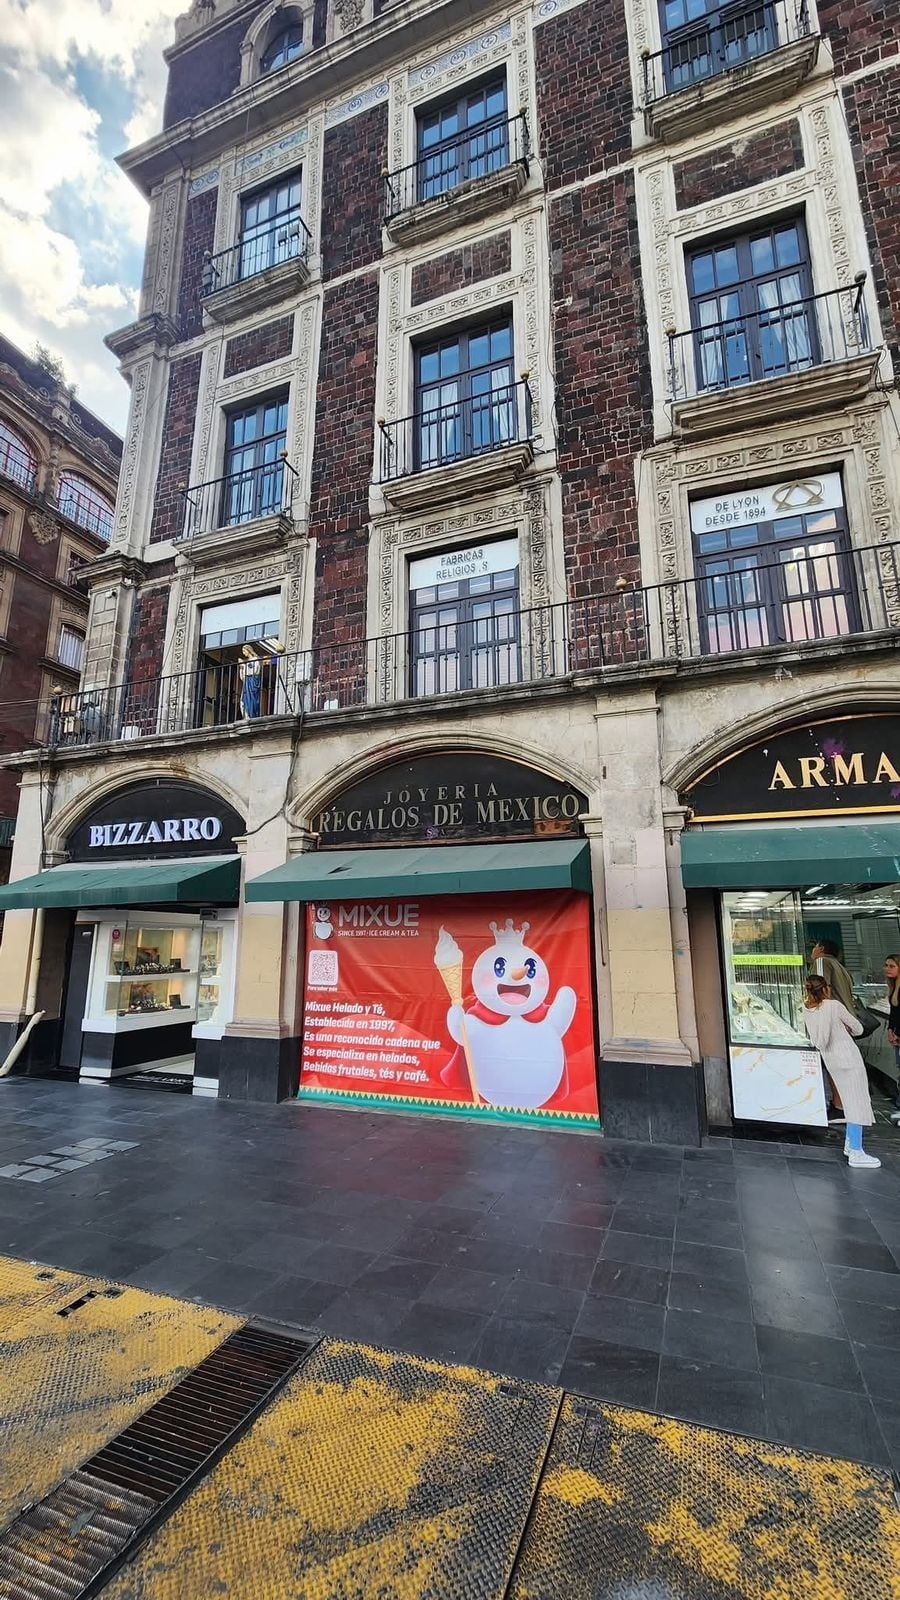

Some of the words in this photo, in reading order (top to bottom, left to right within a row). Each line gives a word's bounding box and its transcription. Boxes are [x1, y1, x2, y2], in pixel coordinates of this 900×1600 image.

[715, 501, 730, 513] DE
[732, 495, 760, 509] LYON
[705, 511, 740, 526] DESDE
[440, 549, 484, 566] FABRICAS
[768, 752, 900, 791] ARMA
[383, 782, 498, 804] JOYERIA
[319, 805, 421, 833] REGALOS
[432, 803, 464, 826] DE
[476, 794, 580, 824] MEXICO
[89, 816, 222, 847] BIZZARRO
[338, 904, 420, 927] MIXUE
[304, 1001, 331, 1012] Mixue
[332, 1003, 363, 1013] Helado
[365, 1006, 371, 1016] y
[372, 1004, 386, 1016] Té,
[304, 1016, 355, 1028] Establecida
[355, 1020, 368, 1029] en
[368, 1020, 396, 1032] 1997,
[303, 1031, 314, 1041] Es
[315, 1033, 332, 1042] una
[333, 1034, 383, 1045] reconocida
[384, 1037, 420, 1048] cadena
[421, 1040, 441, 1051] que
[303, 1046, 315, 1056] Se
[316, 1048, 365, 1060] especializa
[366, 1051, 378, 1060] en
[379, 1051, 420, 1066] helados,
[303, 1061, 337, 1072] Bebidas
[337, 1064, 377, 1078] frutales,
[379, 1068, 395, 1079] tés
[396, 1072, 404, 1082] y
[404, 1070, 430, 1082] café.
